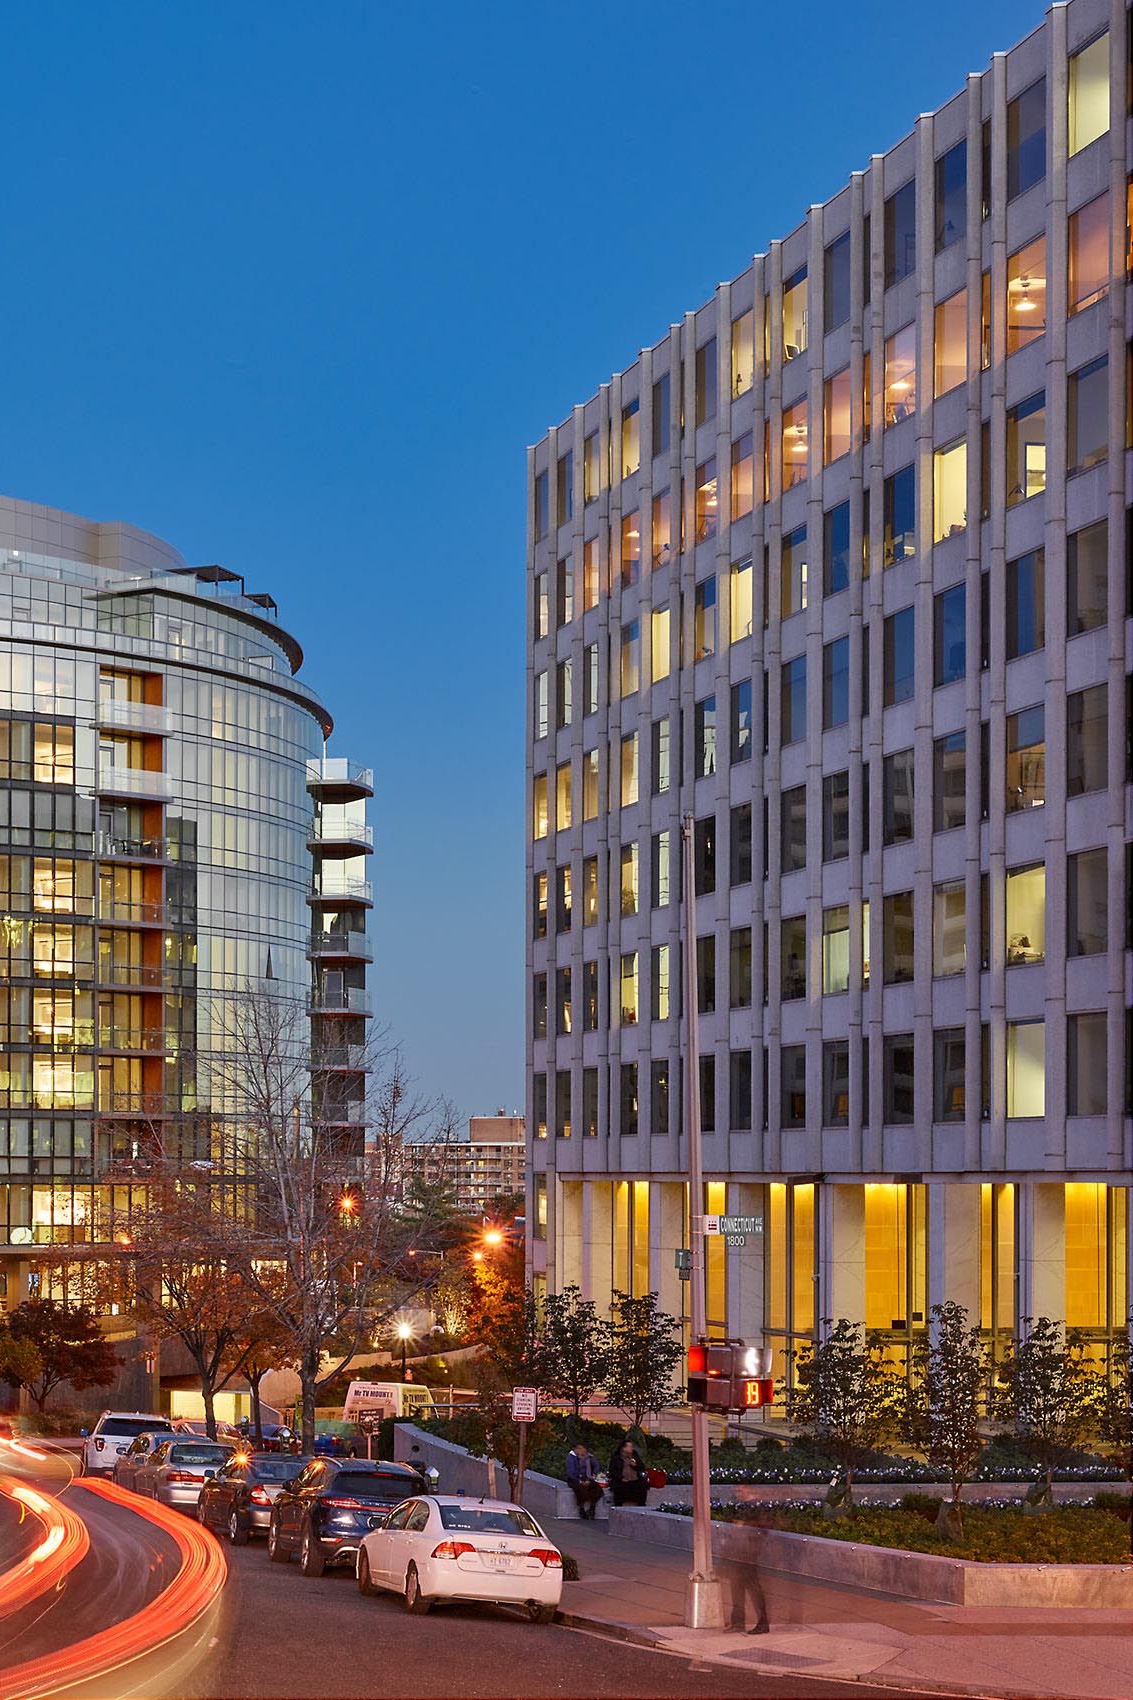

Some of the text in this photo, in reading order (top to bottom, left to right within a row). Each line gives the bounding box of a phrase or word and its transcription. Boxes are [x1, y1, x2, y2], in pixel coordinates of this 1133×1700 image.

[721, 1217, 763, 1232] CONNECTICUT AVE
[727, 1235, 745, 1246] 1800
